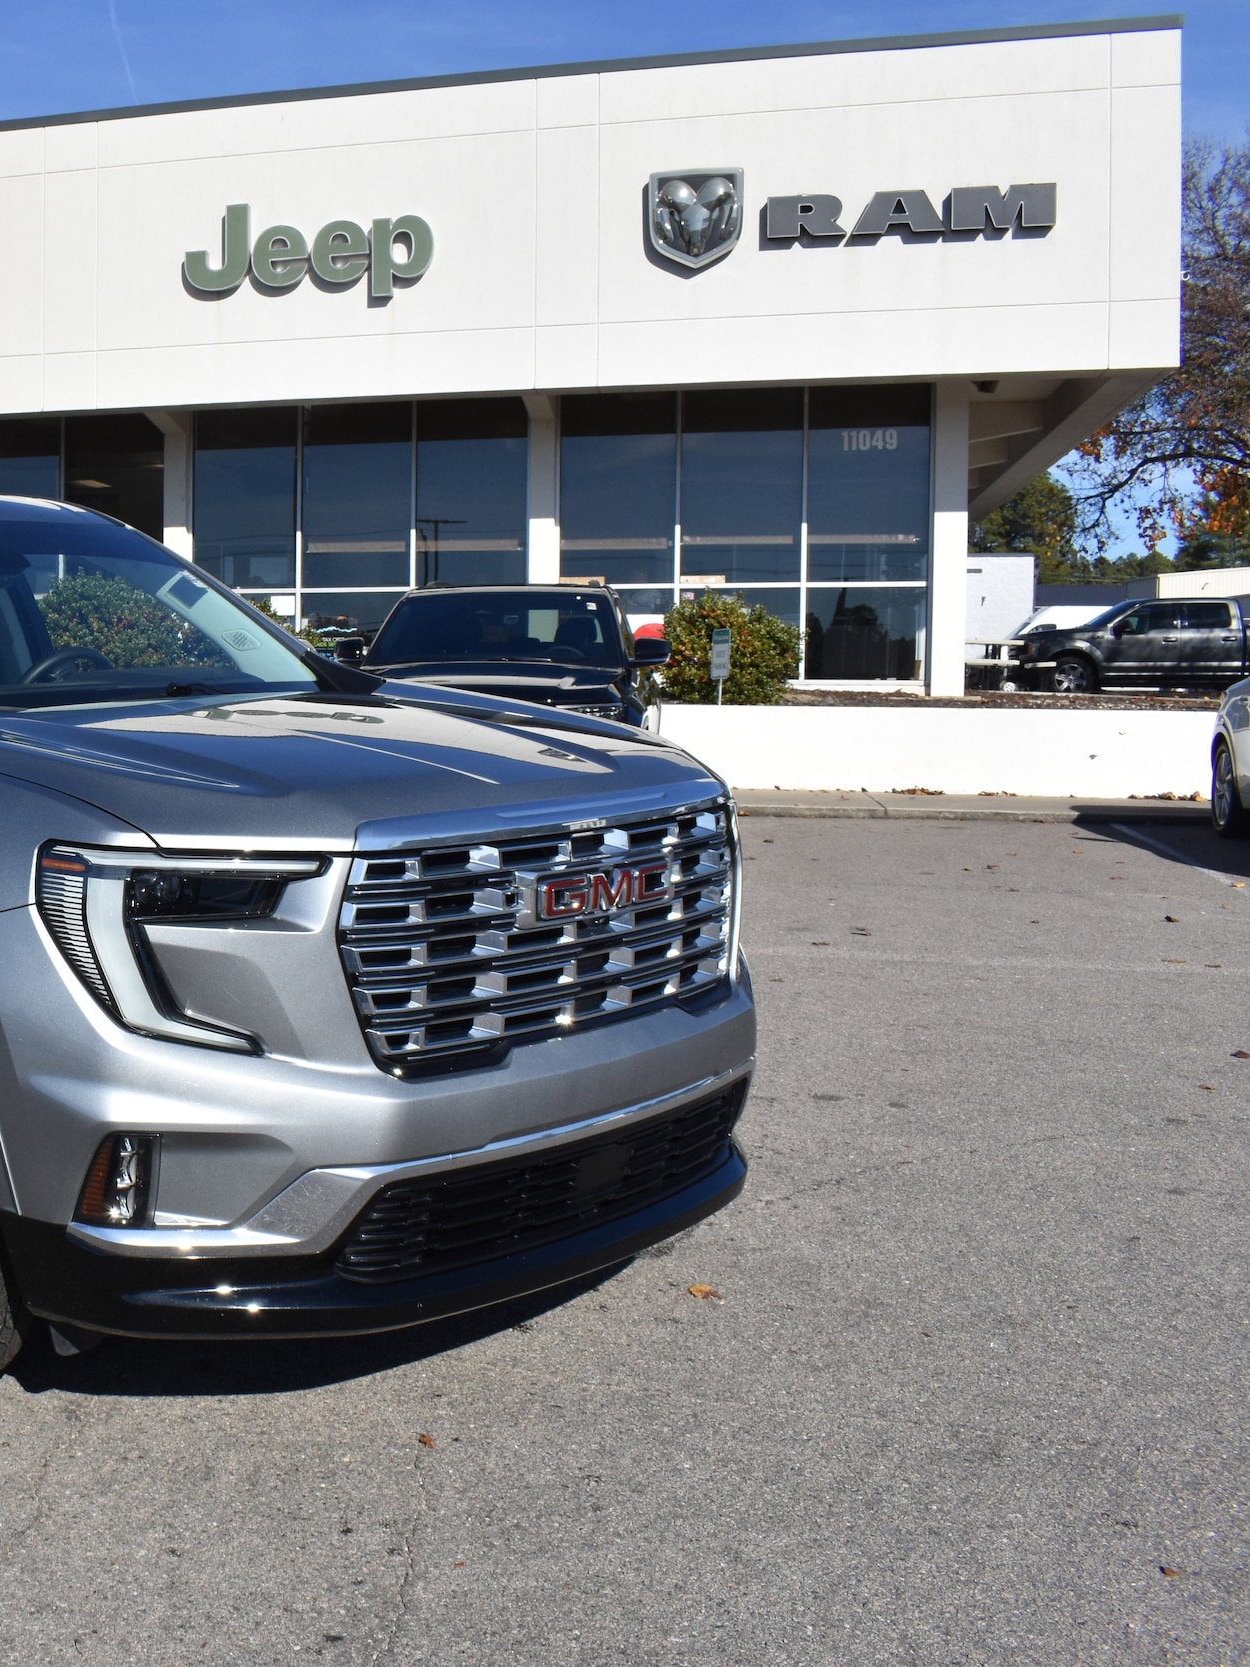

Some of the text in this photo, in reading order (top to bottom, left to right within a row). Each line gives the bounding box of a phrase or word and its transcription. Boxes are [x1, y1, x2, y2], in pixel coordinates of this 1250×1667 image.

[766, 182, 1058, 245] RAM
[183, 202, 435, 299] Jeep
[841, 429, 899, 451] 11049
[542, 862, 670, 918] GMC
